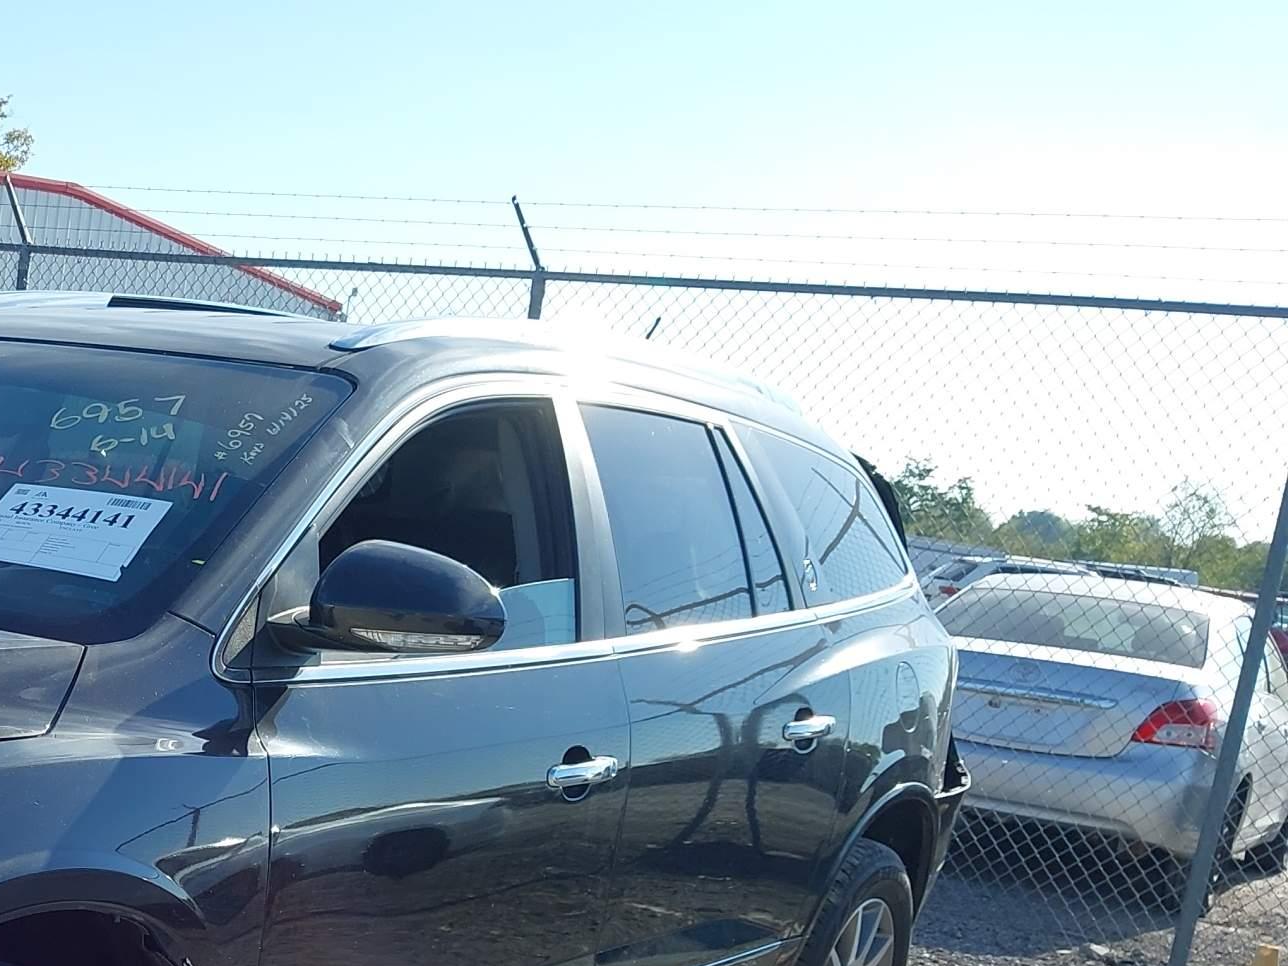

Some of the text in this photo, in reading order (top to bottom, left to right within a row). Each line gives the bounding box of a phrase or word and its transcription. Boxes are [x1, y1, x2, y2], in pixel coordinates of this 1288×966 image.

[50, 395, 186, 429] 6957
[90, 423, 176, 453] 6-14
[214, 412, 264, 460] #6957
[9, 501, 136, 529] 43344141
